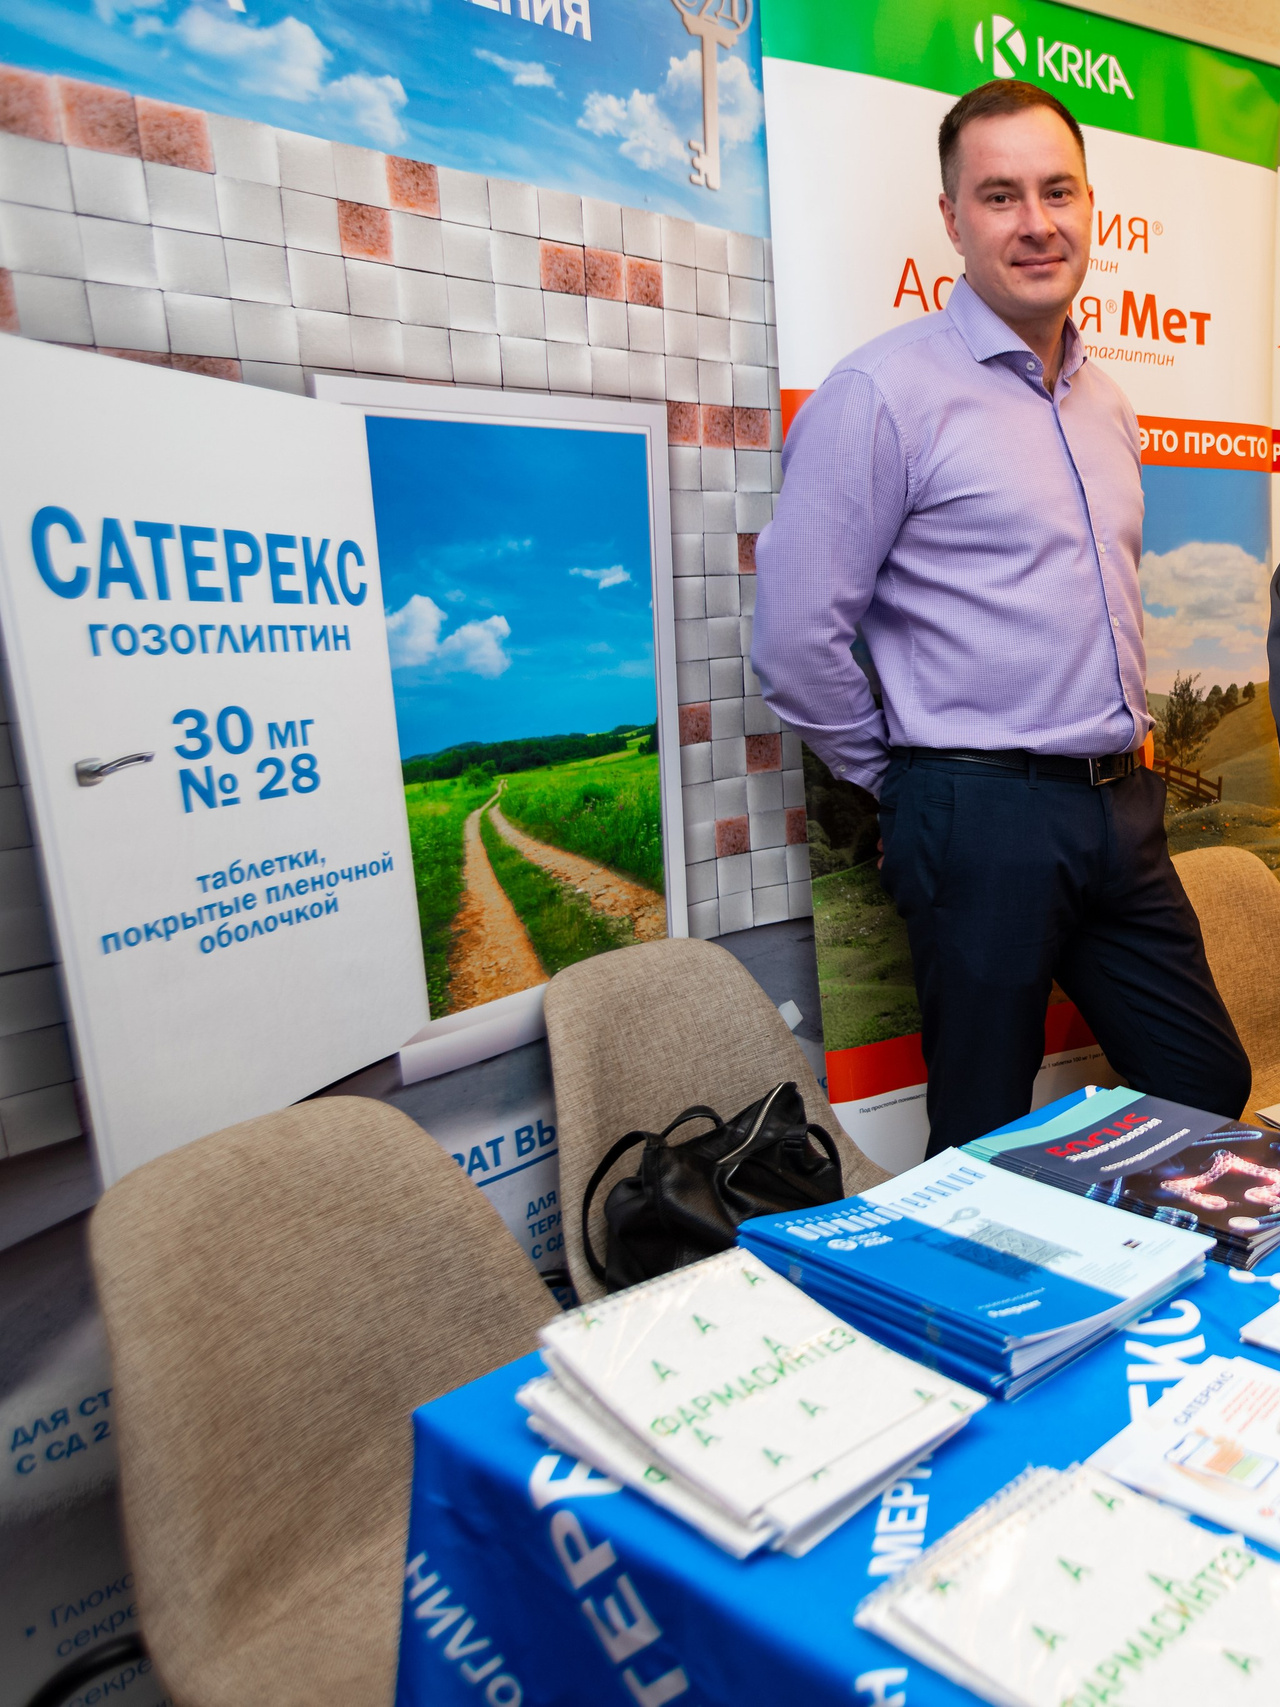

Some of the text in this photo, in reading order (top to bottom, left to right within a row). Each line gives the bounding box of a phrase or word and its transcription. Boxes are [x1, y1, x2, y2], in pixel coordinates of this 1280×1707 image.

[1037, 36, 1135, 100] KRKA
[1120, 289, 1211, 346] Мет
[1085, 344, 1175, 367] таглиптин
[1183, 431, 1268, 459] ПРОСТО
[31, 505, 369, 607] САТЕРЕКС
[172, 705, 315, 760] 30 мг
[179, 753, 322, 813] № 28
[196, 848, 327, 894] таблетки,
[100, 851, 395, 956] покрытые пленочной
[200, 895, 340, 955] оболочкой
[650, 1327, 857, 1438] ФАРМАСИНТЕЗ
